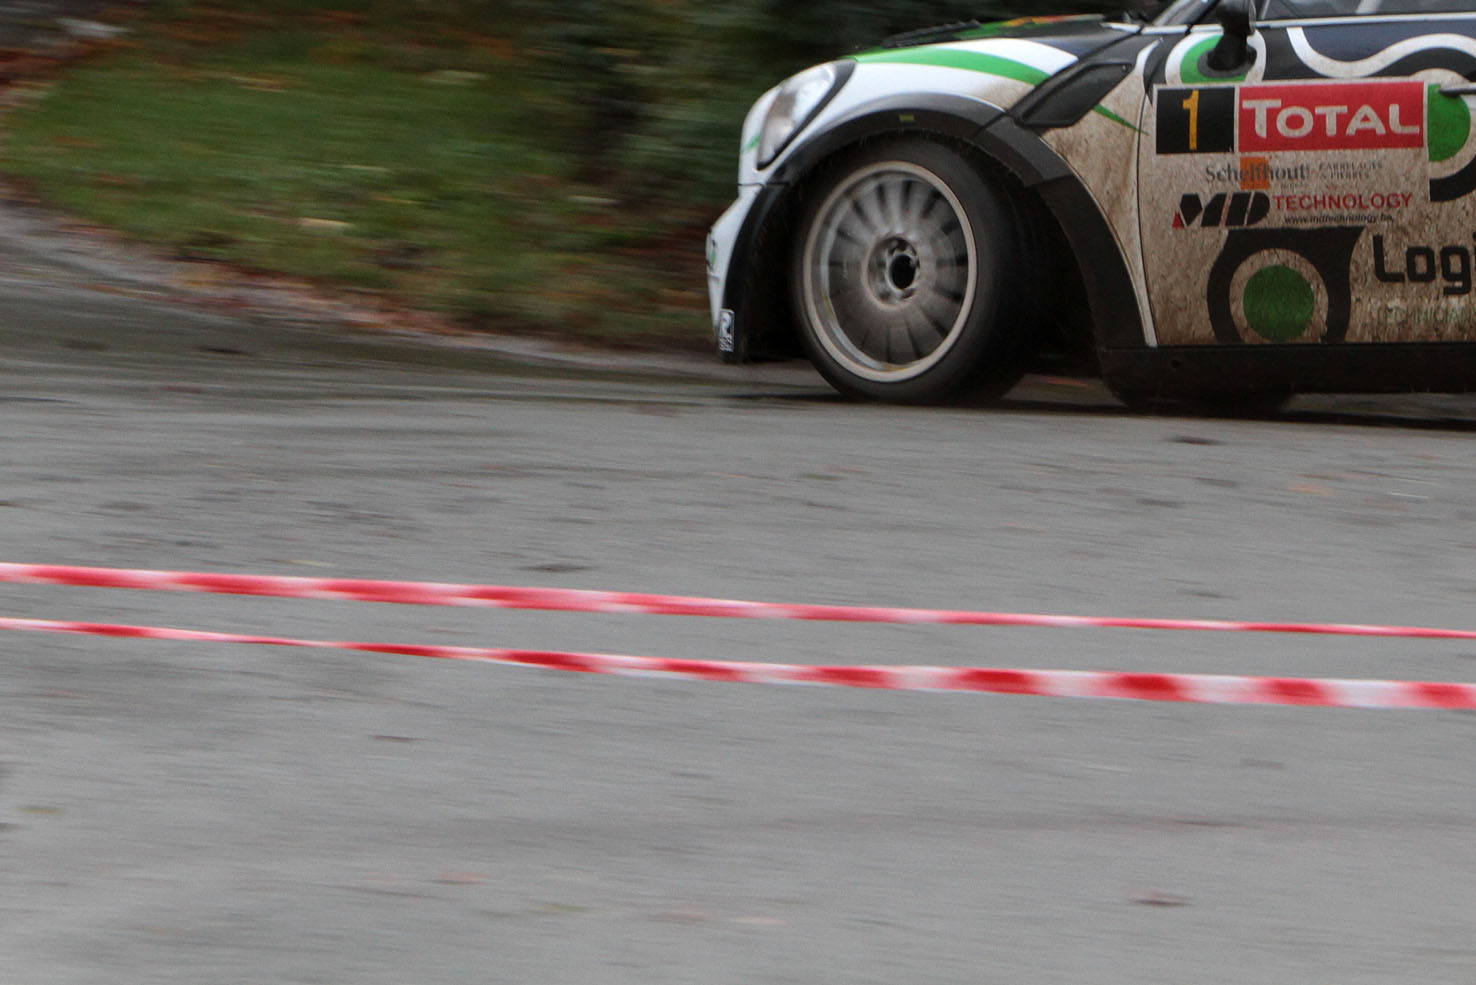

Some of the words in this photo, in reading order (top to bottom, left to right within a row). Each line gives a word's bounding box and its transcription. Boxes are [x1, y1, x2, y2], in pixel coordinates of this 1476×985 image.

[1182, 89, 1200, 151] 1
[1242, 98, 1421, 139] TOTAL
[1273, 192, 1413, 212] TECHNOLOGY
